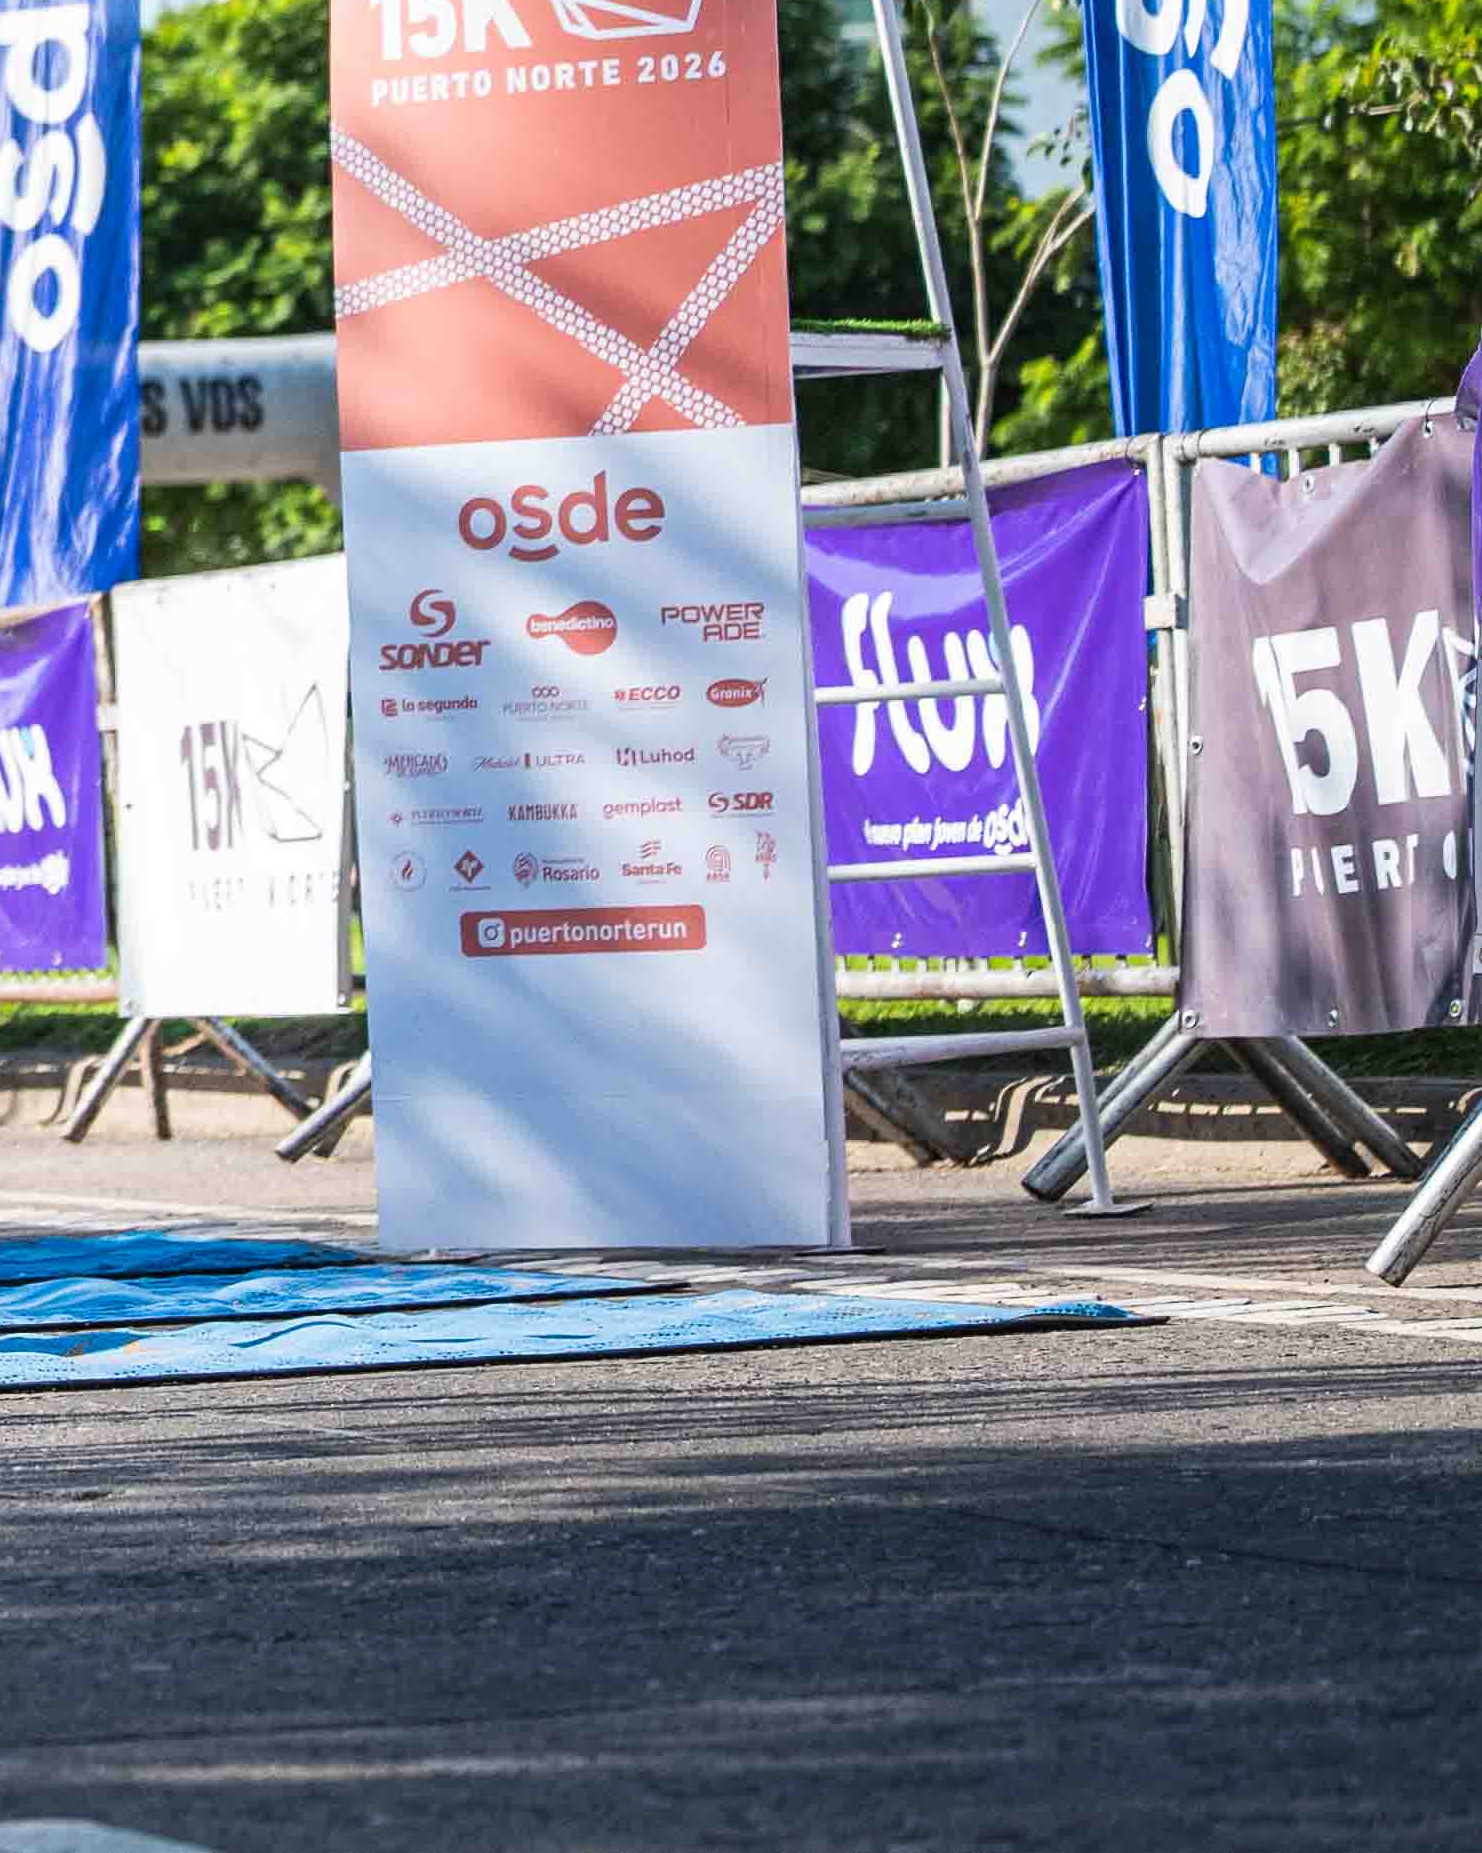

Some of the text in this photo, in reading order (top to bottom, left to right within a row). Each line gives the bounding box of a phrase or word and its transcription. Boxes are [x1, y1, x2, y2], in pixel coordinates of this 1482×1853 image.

[370, 51, 726, 107] PUERTO NORTE 2026
[458, 470, 666, 562] osde
[660, 602, 765, 626] POWER
[702, 622, 762, 643] ADE
[627, 685, 681, 701] ECCO
[418, 695, 478, 715] segunda
[507, 803, 579, 821] KAMBUKKA
[602, 796, 683, 820] gemplast
[732, 792, 774, 811] SDR
[983, 797, 1030, 856] osd
[542, 863, 600, 882] Rosario
[622, 862, 665, 877] Santa
[510, 919, 687, 948] puertonorterun
